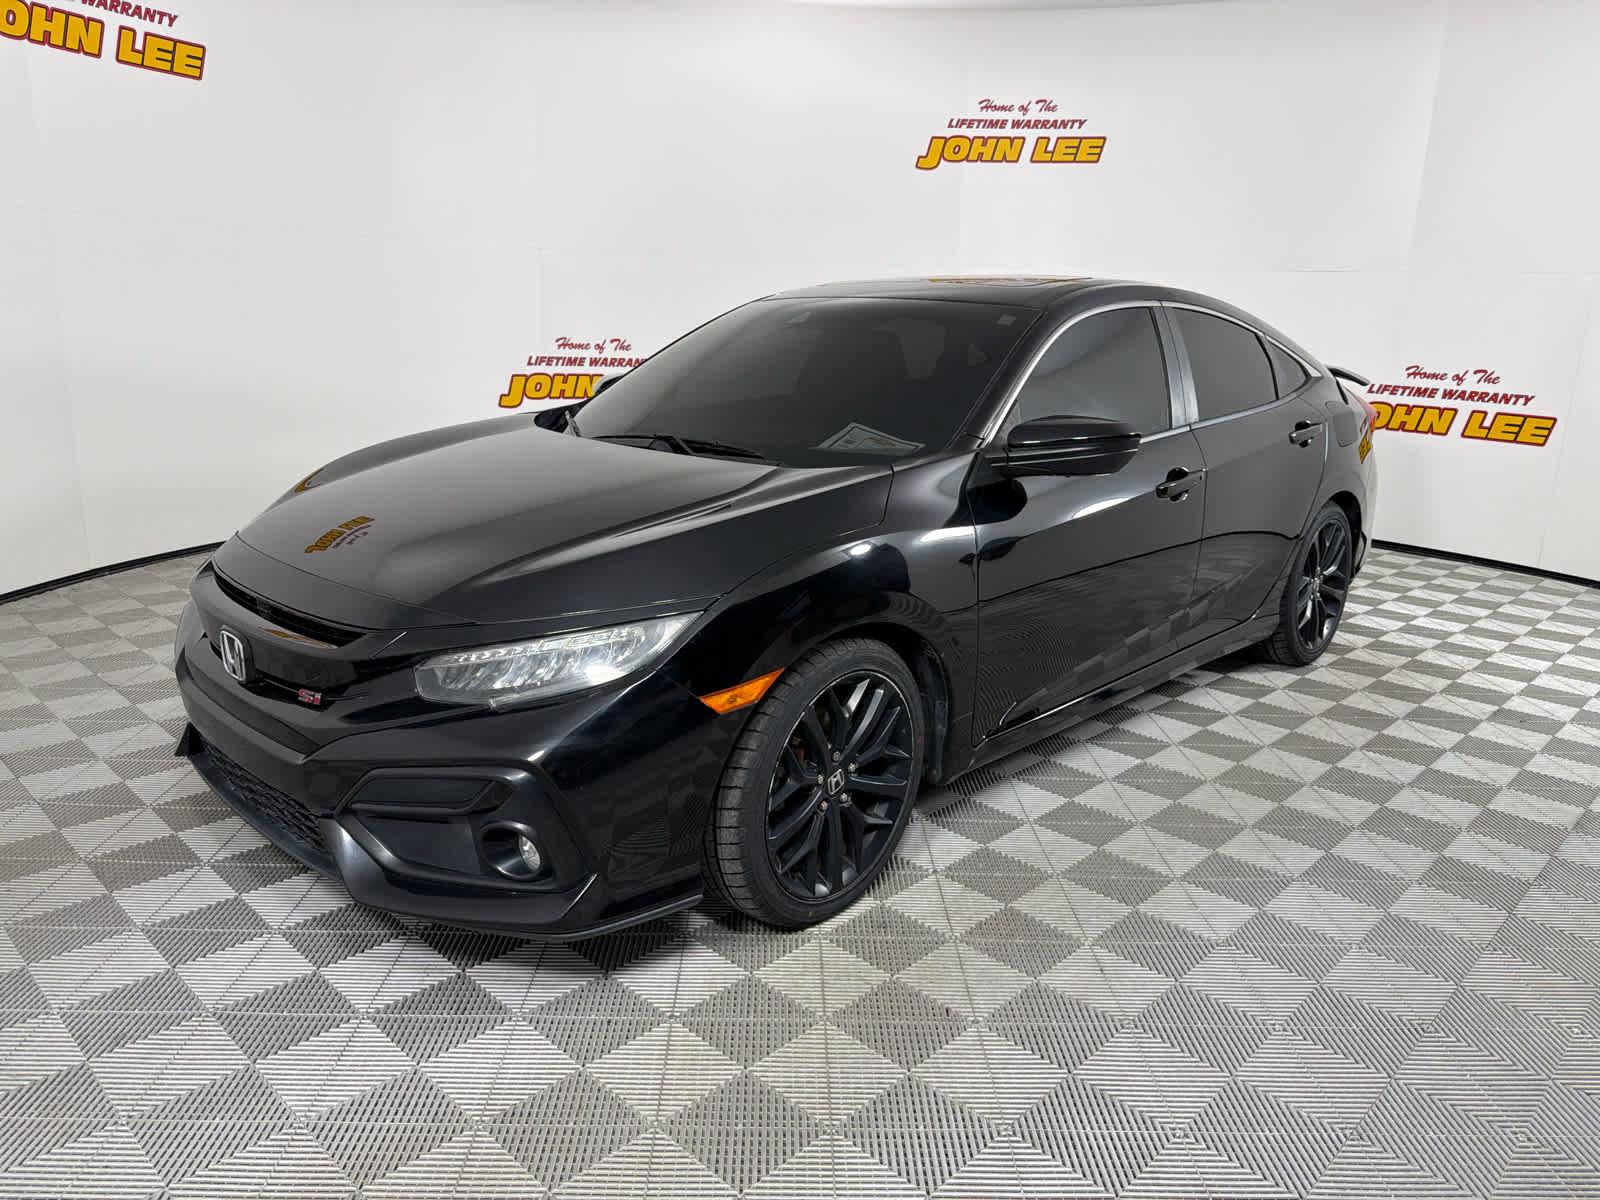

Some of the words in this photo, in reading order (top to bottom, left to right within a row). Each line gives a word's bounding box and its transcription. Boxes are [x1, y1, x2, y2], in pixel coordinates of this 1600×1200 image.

[0, 0, 104, 58] OHN
[116, 25, 206, 80] LEE
[978, 98, 1014, 113] Home
[1018, 101, 1031, 116] of
[1035, 99, 1058, 113] The
[947, 118, 1008, 129] LIFETIME
[1011, 119, 1087, 130] WARRANTY
[916, 135, 1025, 170] JOHN
[1030, 136, 1106, 163] LEE
[555, 337, 591, 351] Home
[594, 339, 606, 354] of
[610, 338, 632, 351] The
[527, 355, 585, 367] LIFETIME
[1405, 365, 1448, 381] Home
[1452, 370, 1469, 386] of
[1474, 369, 1501, 385] The
[498, 372, 604, 408] JOHN
[1367, 383, 1439, 399] LIFETIME
[1441, 389, 1536, 407] WARRANTY
[1366, 401, 1458, 436] OHN
[1461, 410, 1558, 447] LEE
[298, 688, 323, 705] Si
